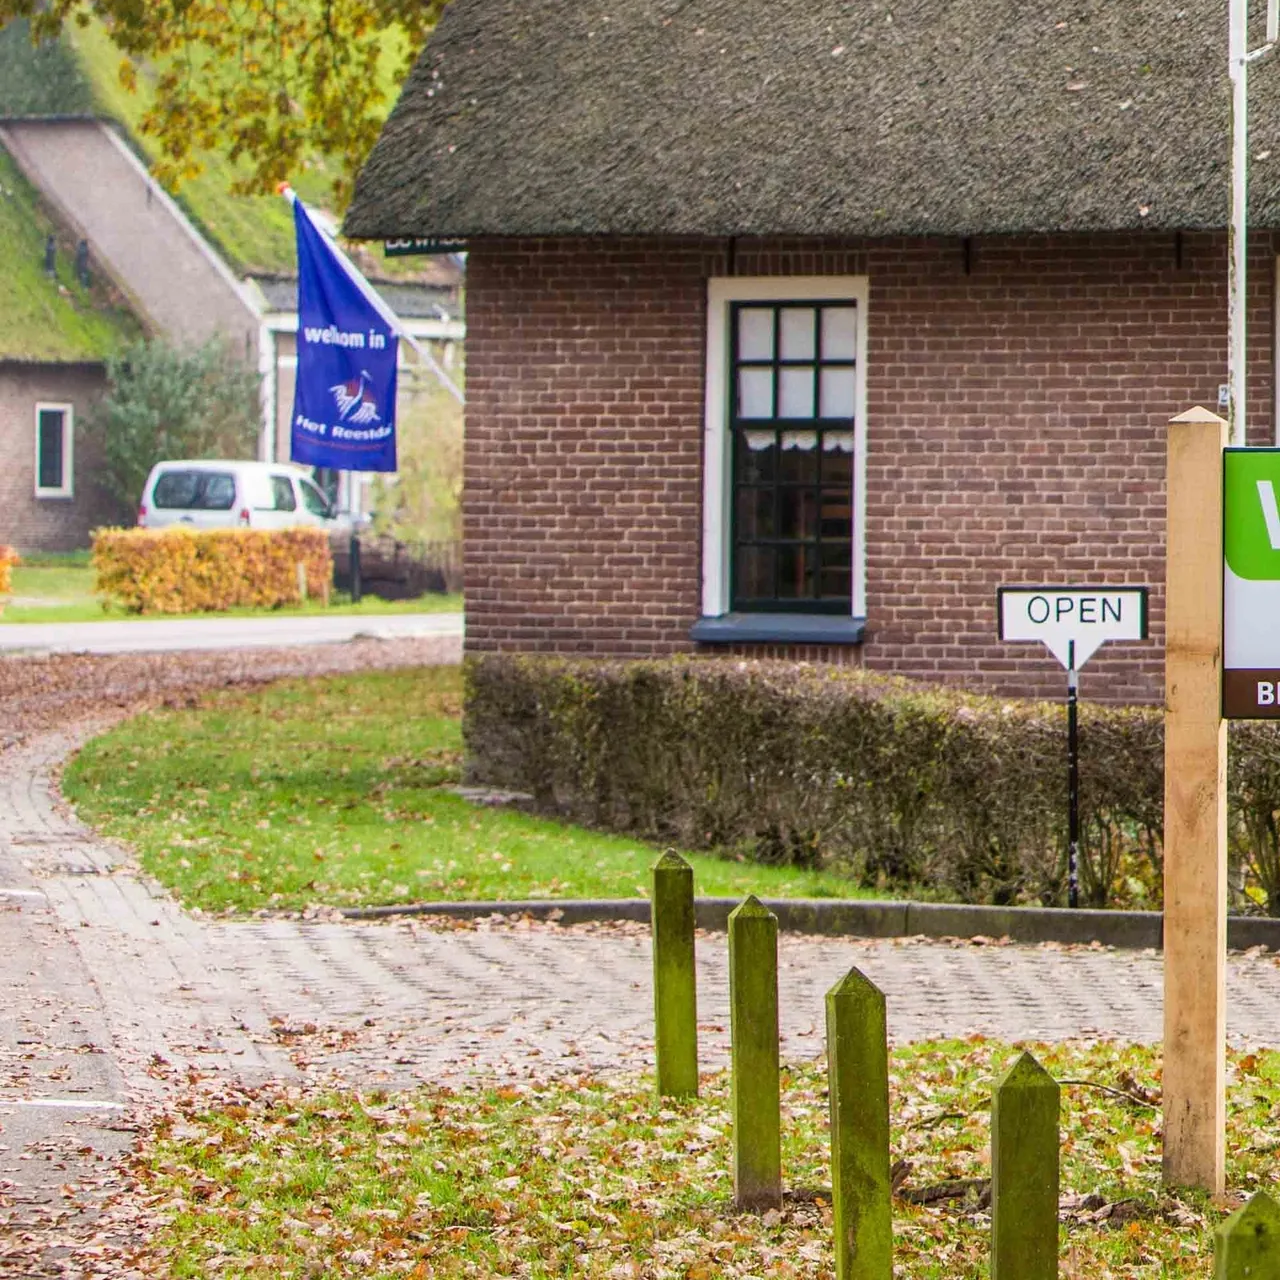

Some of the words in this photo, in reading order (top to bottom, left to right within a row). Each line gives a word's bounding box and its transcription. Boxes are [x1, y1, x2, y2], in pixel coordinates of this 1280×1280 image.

[369, 328, 385, 349] in
[296, 414, 326, 435] Het
[1028, 596, 1121, 623] OPEN
